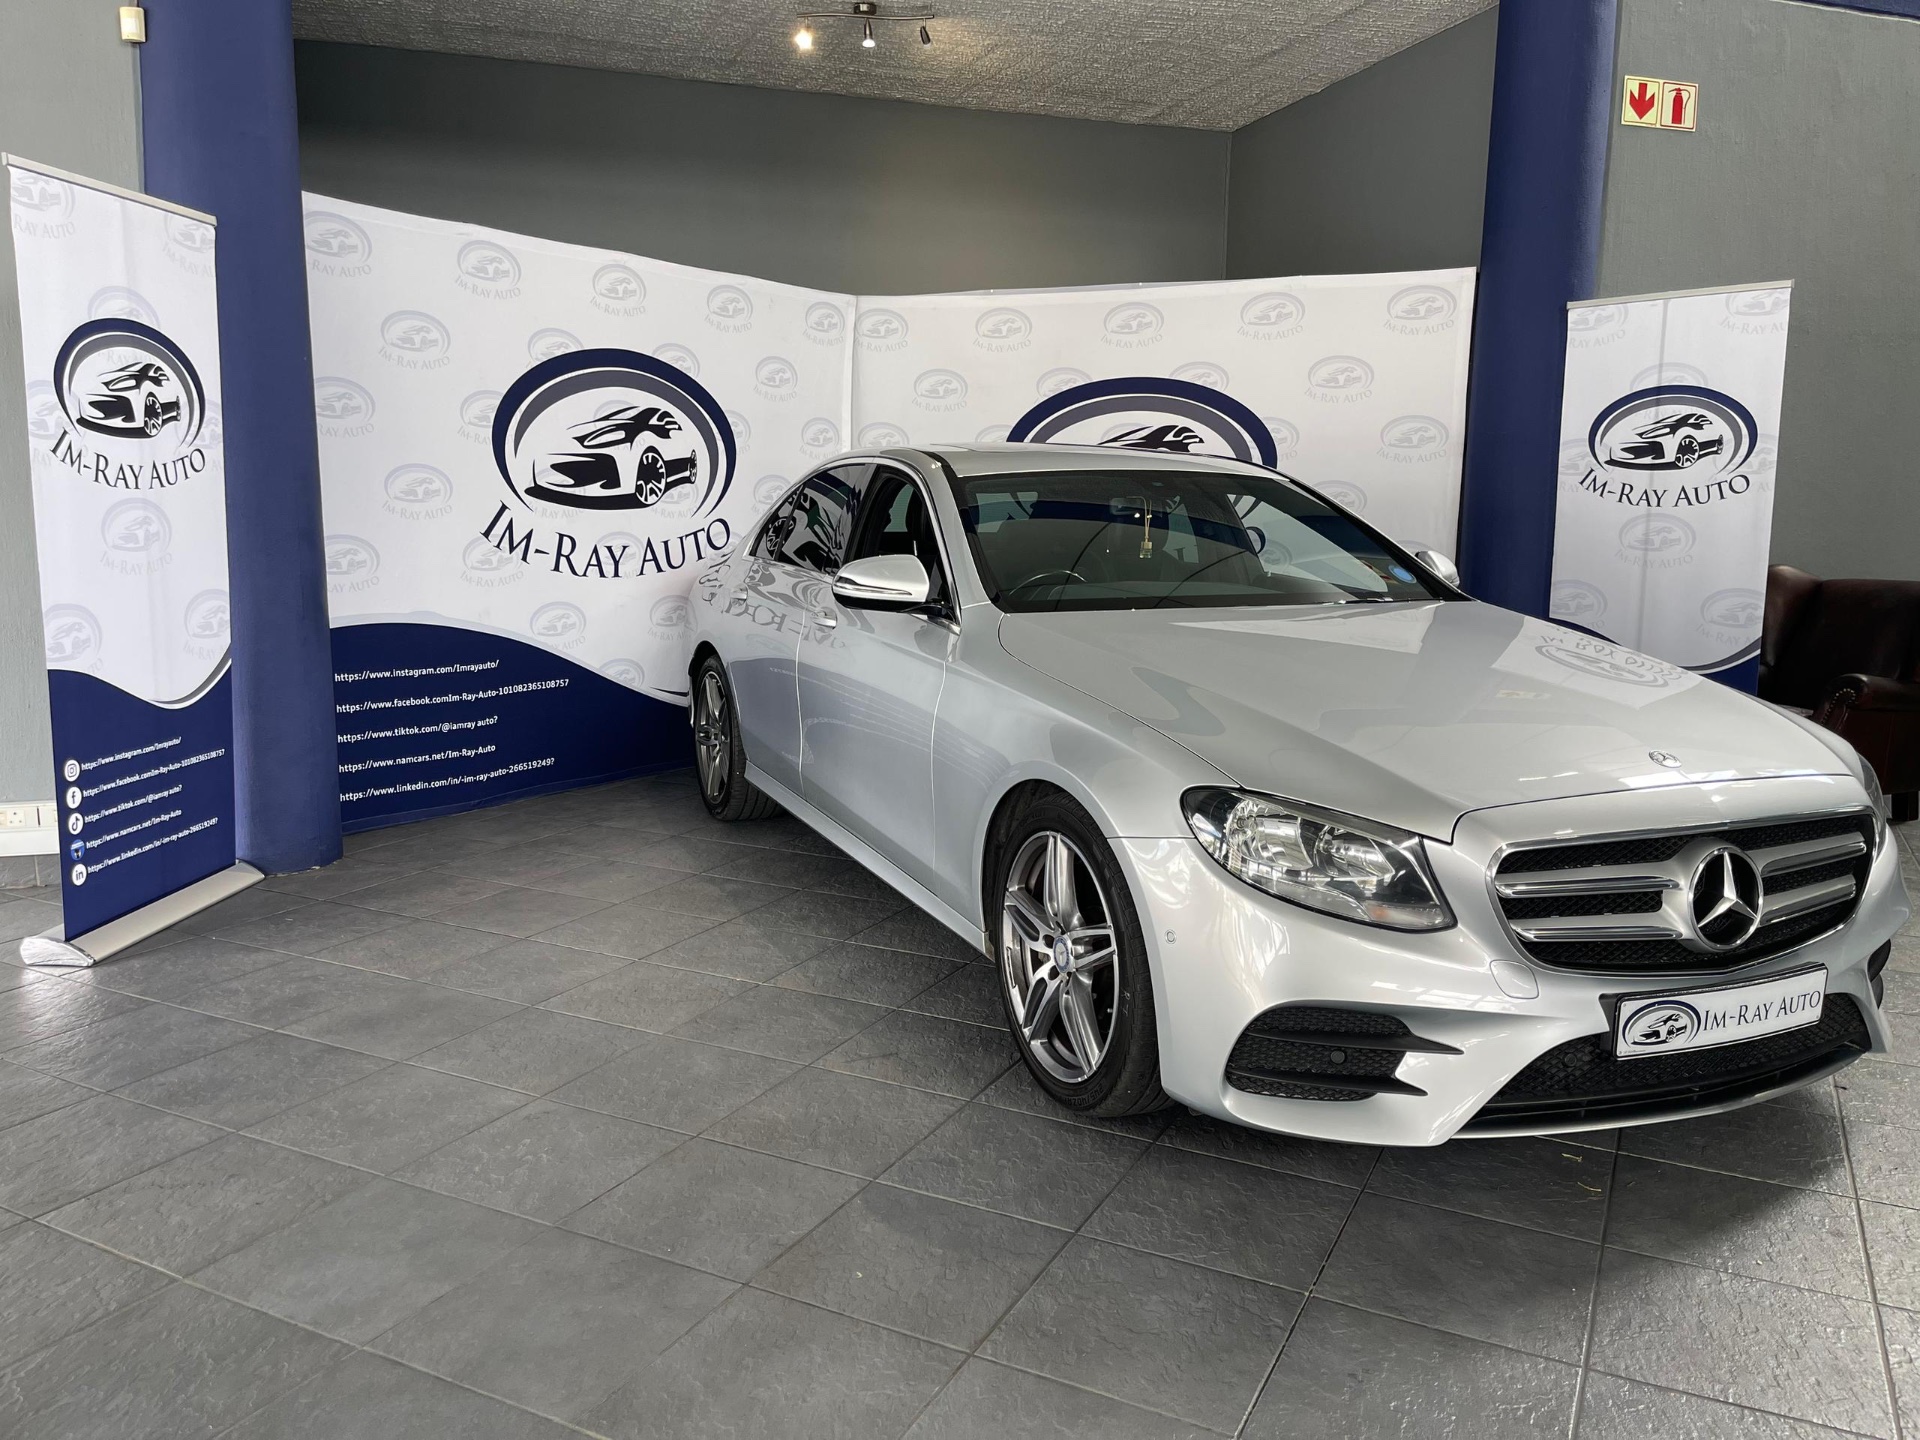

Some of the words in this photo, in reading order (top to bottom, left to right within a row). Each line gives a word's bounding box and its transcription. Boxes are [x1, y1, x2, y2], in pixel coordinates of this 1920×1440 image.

[13, 213, 38, 237] RAY
[308, 259, 336, 276] -RAY
[340, 264, 372, 278] AUTO
[454, 275, 492, 299] IM-RAY
[493, 287, 521, 300] AUTO
[622, 306, 646, 317] AUTO
[1237, 326, 1273, 341] IM-RAY
[1274, 325, 1303, 341] AUTO
[1383, 319, 1422, 337] IM-RAY
[1424, 318, 1454, 336] AUTO
[885, 340, 908, 353] AUTO
[972, 338, 1005, 353] IM-RAY
[1005, 338, 1032, 353] AUTO
[1100, 334, 1136, 349] IM-RAY
[1137, 333, 1163, 348] AUTO
[1568, 337, 1591, 348] RAY
[378, 346, 418, 370] IM-RAY
[420, 356, 450, 370] AUTO
[1304, 388, 1341, 404] IM-RAY
[1343, 389, 1373, 404] AUTO
[943, 400, 968, 413] AUTO
[342, 423, 374, 438] AUTO
[48, 426, 145, 490] IM-RAY
[147, 447, 206, 491] AUTO
[1376, 448, 1415, 464] IM-RAY
[1416, 449, 1447, 463] AUTO
[1577, 466, 1669, 508] IM-RAY
[1672, 473, 1751, 508] AUTO
[381, 501, 422, 520] IM-RAY
[424, 505, 452, 520] AUTO
[479, 499, 630, 579] IM-RAY
[636, 517, 731, 578] AUTO
[147, 552, 173, 575] AUTO
[1658, 554, 1693, 569] AUTO
[347, 575, 380, 593] AUTO
[460, 570, 496, 588] IM-RAY
[497, 571, 524, 587] AUTO
[561, 636, 586, 651] AUTO
[334, 659, 500, 683] https://www.instagram.com/Imrayauto/
[338, 744, 496, 774] https://www.namcars.net/Im-Ray-Auto
[339, 757, 555, 803] https://www.linkedin.com/in/-im-ray-auto-266519249?
[1702, 1001, 1774, 1032] IM-RAY
[1775, 990, 1822, 1019] AUTO
